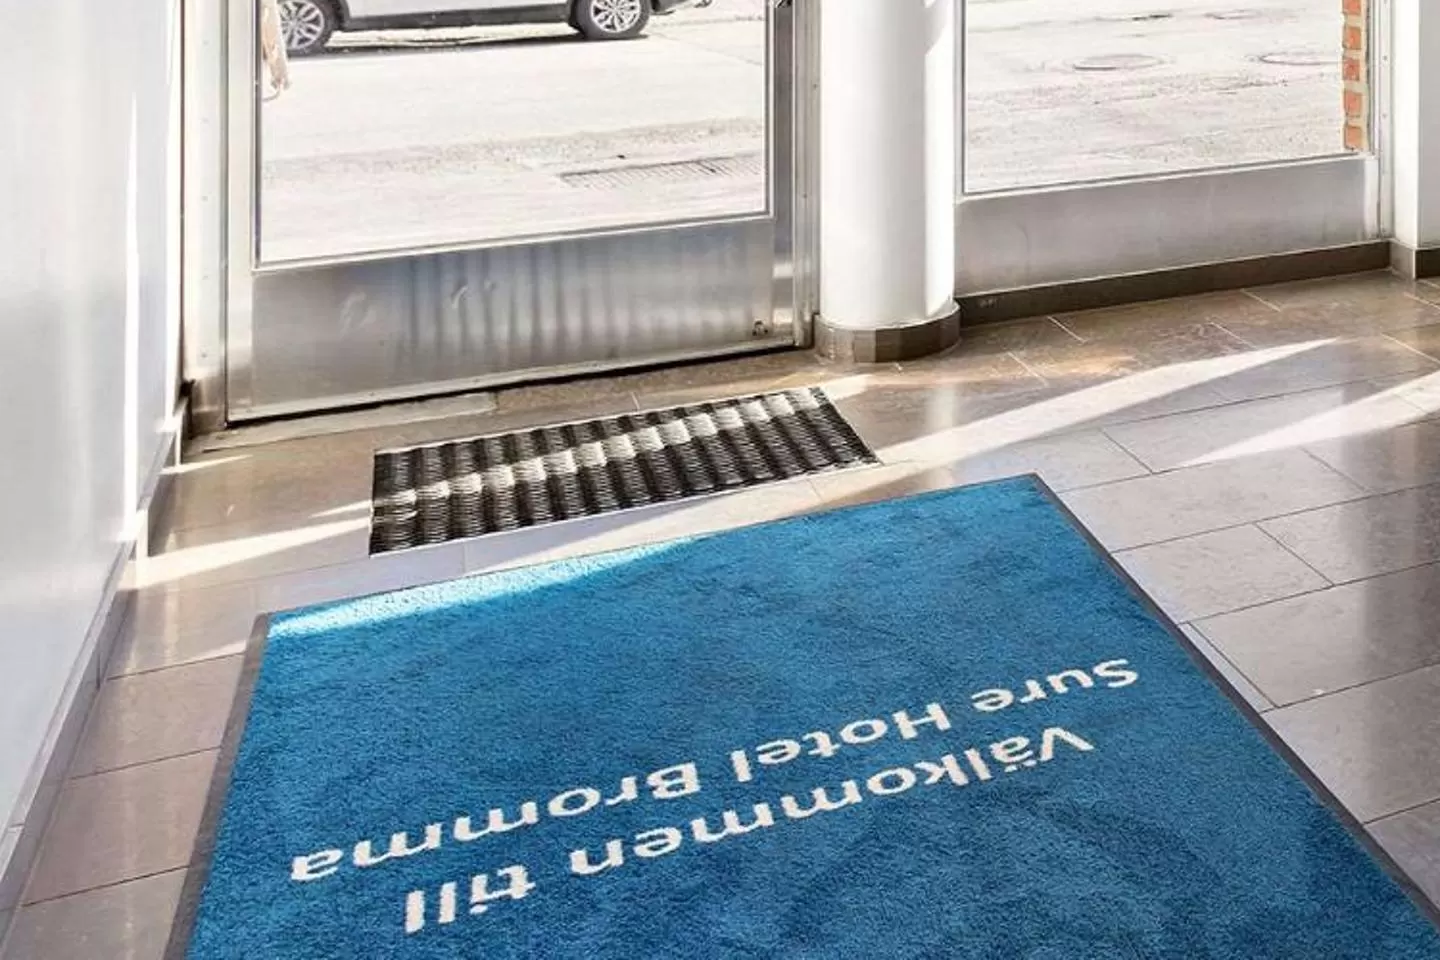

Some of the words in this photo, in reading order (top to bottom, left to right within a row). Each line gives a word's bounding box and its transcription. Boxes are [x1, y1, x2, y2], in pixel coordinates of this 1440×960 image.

[971, 658, 1139, 712] Sure
[730, 702, 951, 783] Hotel
[290, 762, 701, 882] Bromma
[569, 727, 1093, 876] Välkommen
[405, 864, 536, 933] till
